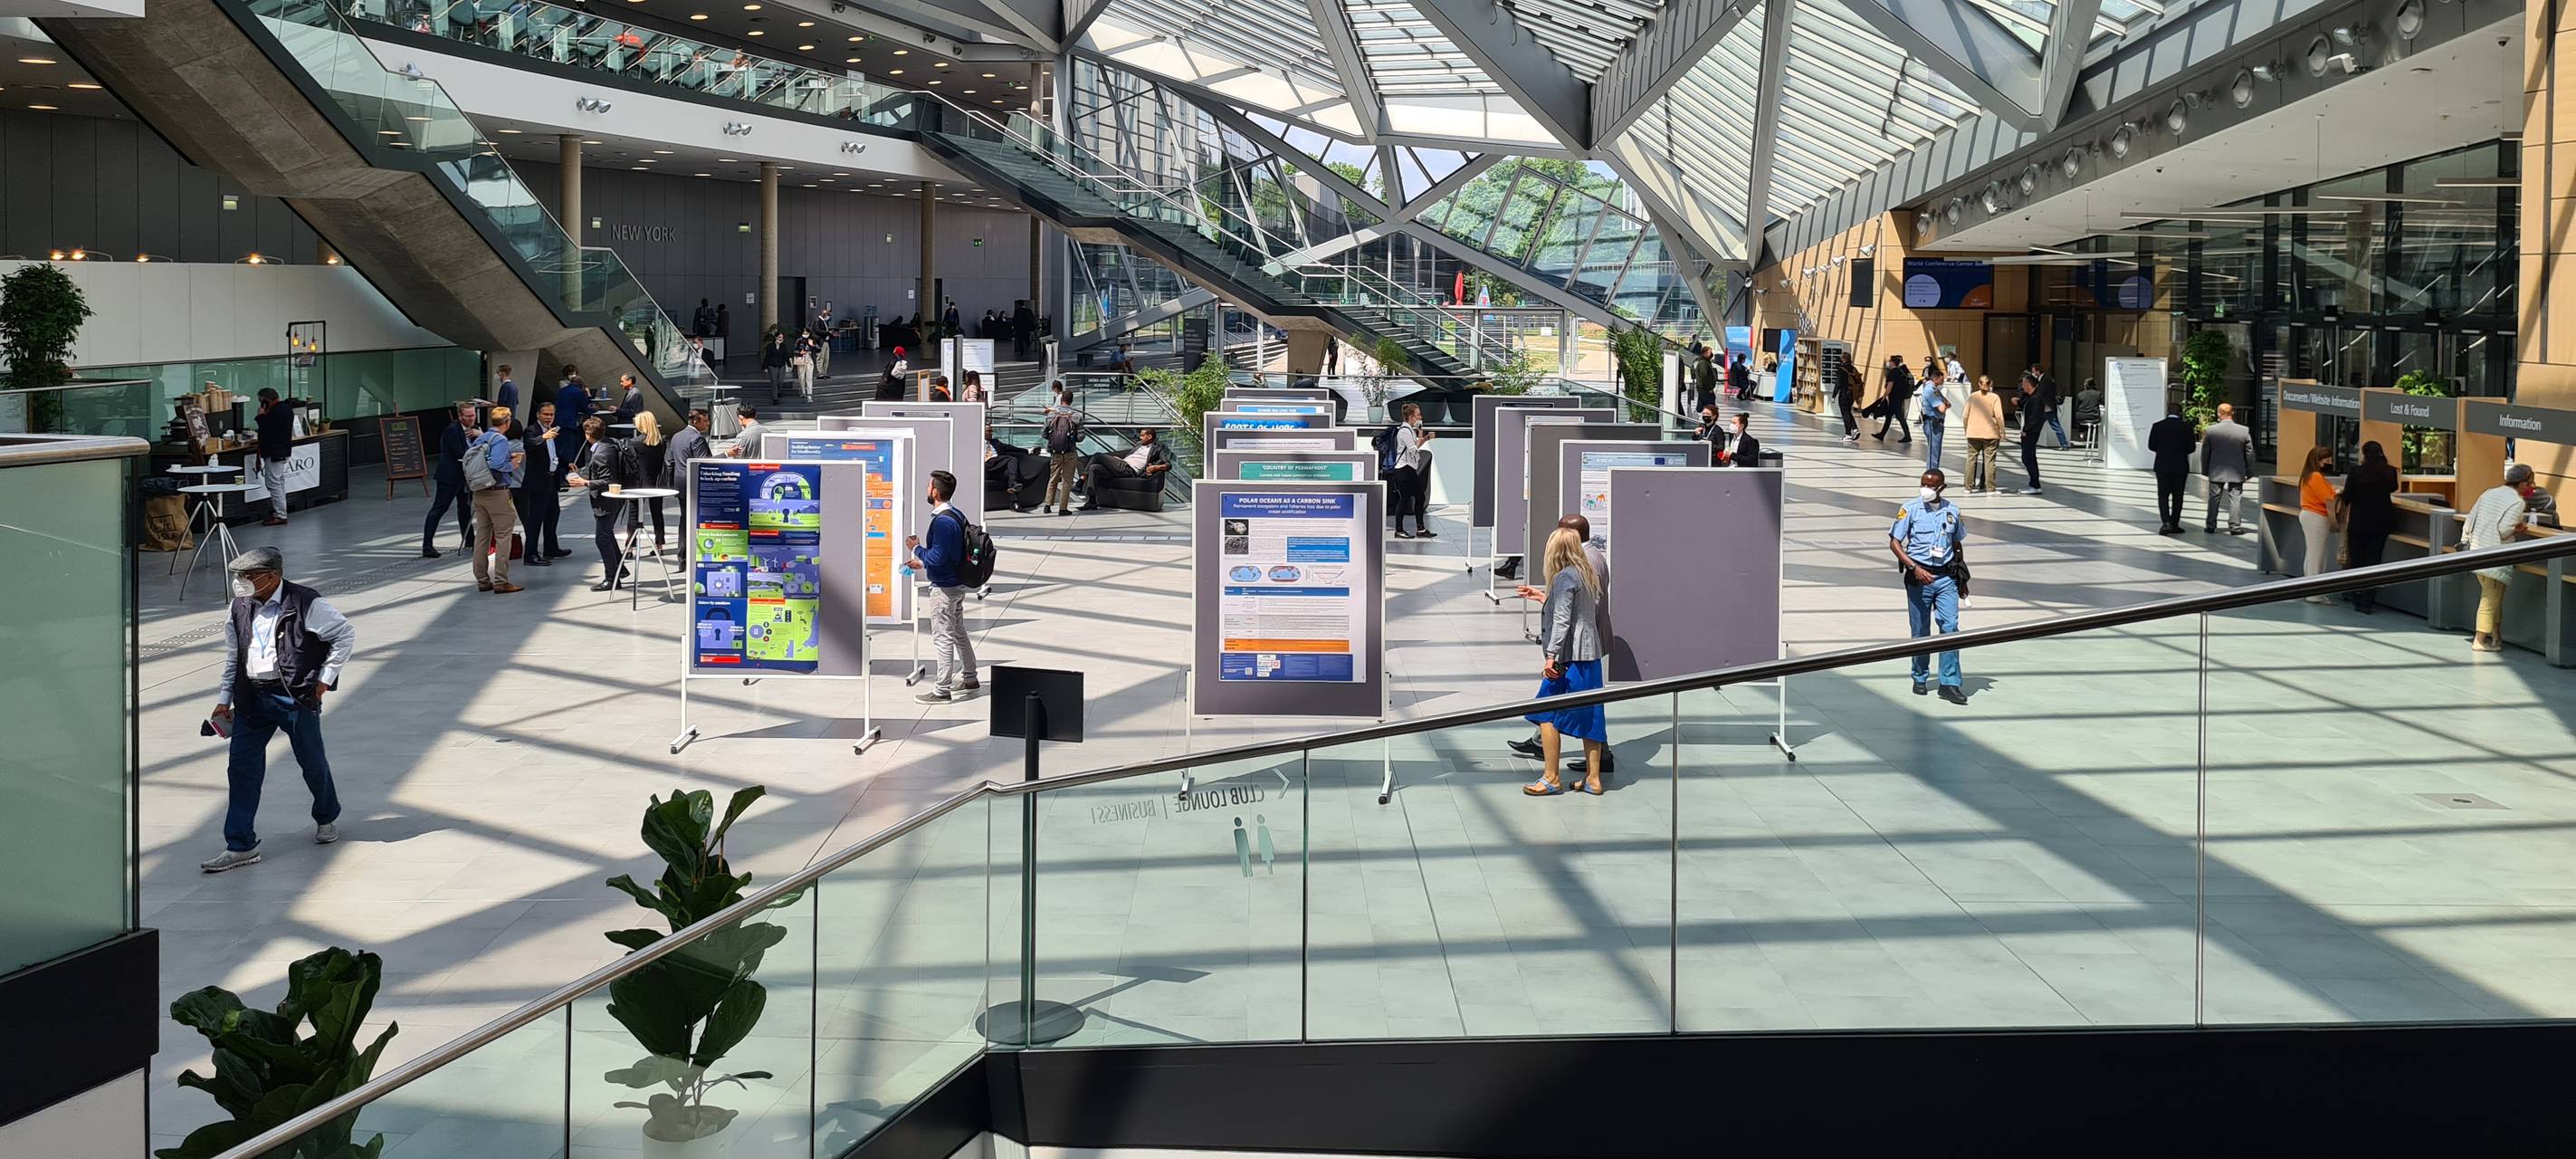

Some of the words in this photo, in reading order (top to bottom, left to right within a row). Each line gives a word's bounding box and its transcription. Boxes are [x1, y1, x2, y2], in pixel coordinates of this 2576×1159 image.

[611, 224, 641, 241] NEW
[643, 225, 676, 244] YORK
[2283, 389, 2309, 404] Documents
[2331, 395, 2361, 409] Information
[2390, 402, 2403, 416] Lost
[2403, 404, 2409, 416] &
[2410, 404, 2429, 418] Found
[2499, 414, 2542, 432] Information
